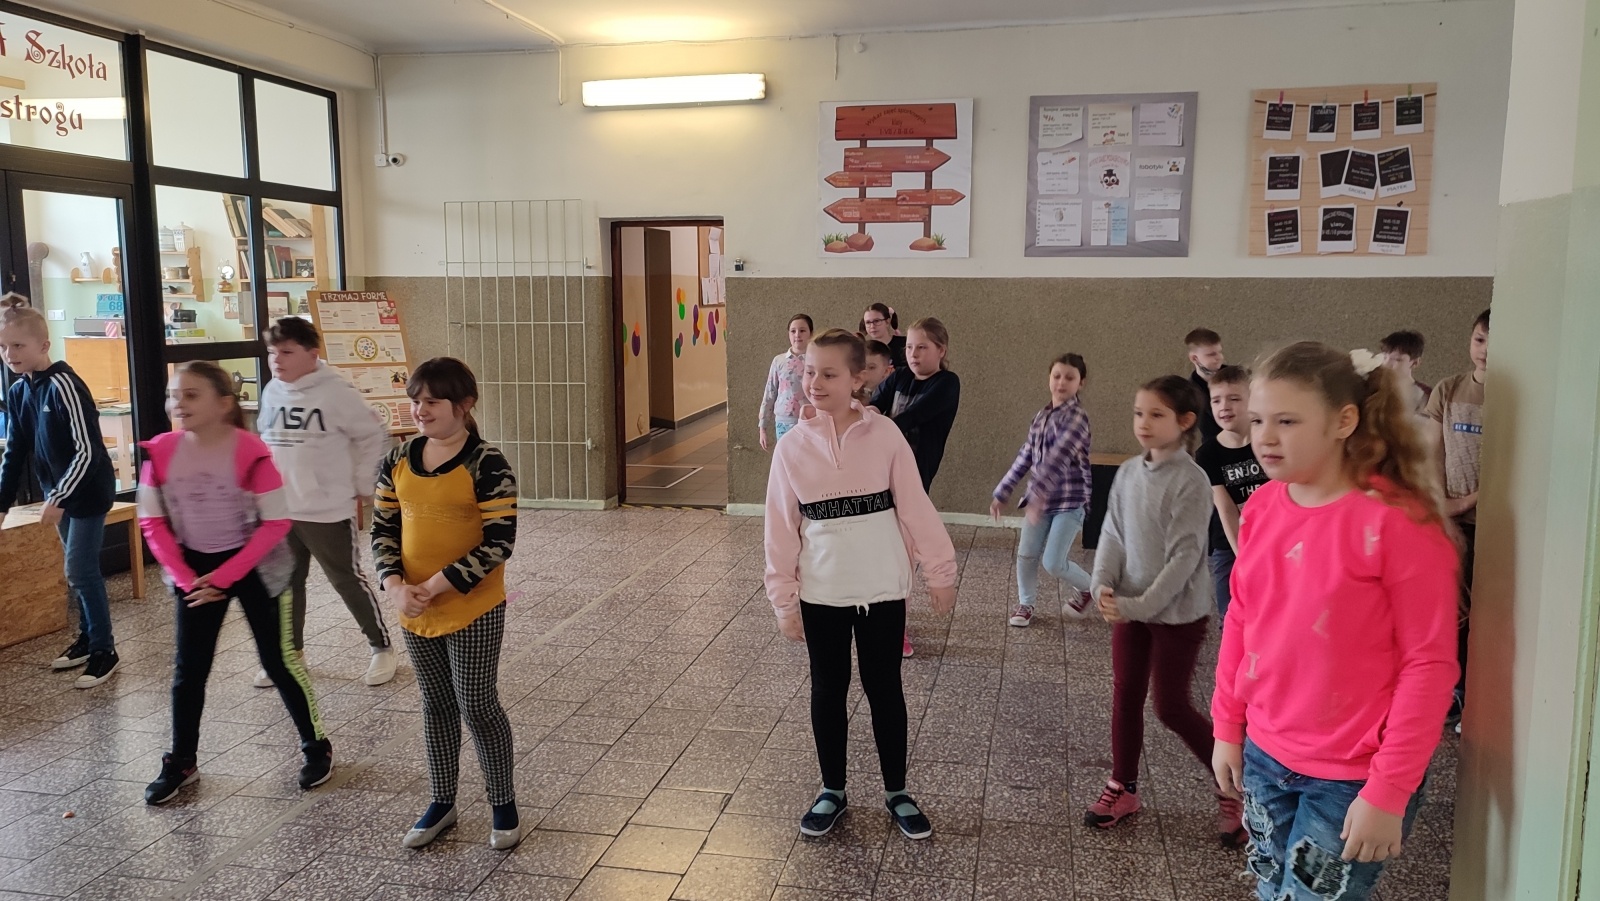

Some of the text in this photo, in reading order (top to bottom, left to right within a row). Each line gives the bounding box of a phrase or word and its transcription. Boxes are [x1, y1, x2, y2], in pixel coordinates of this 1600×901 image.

[24, 29, 107, 81] Szkoła
[321, 292, 359, 301] TRZYMAJ
[109, 301, 123, 311] 68
[269, 406, 326, 431] ASA
[1227, 463, 1260, 481] ENJO
